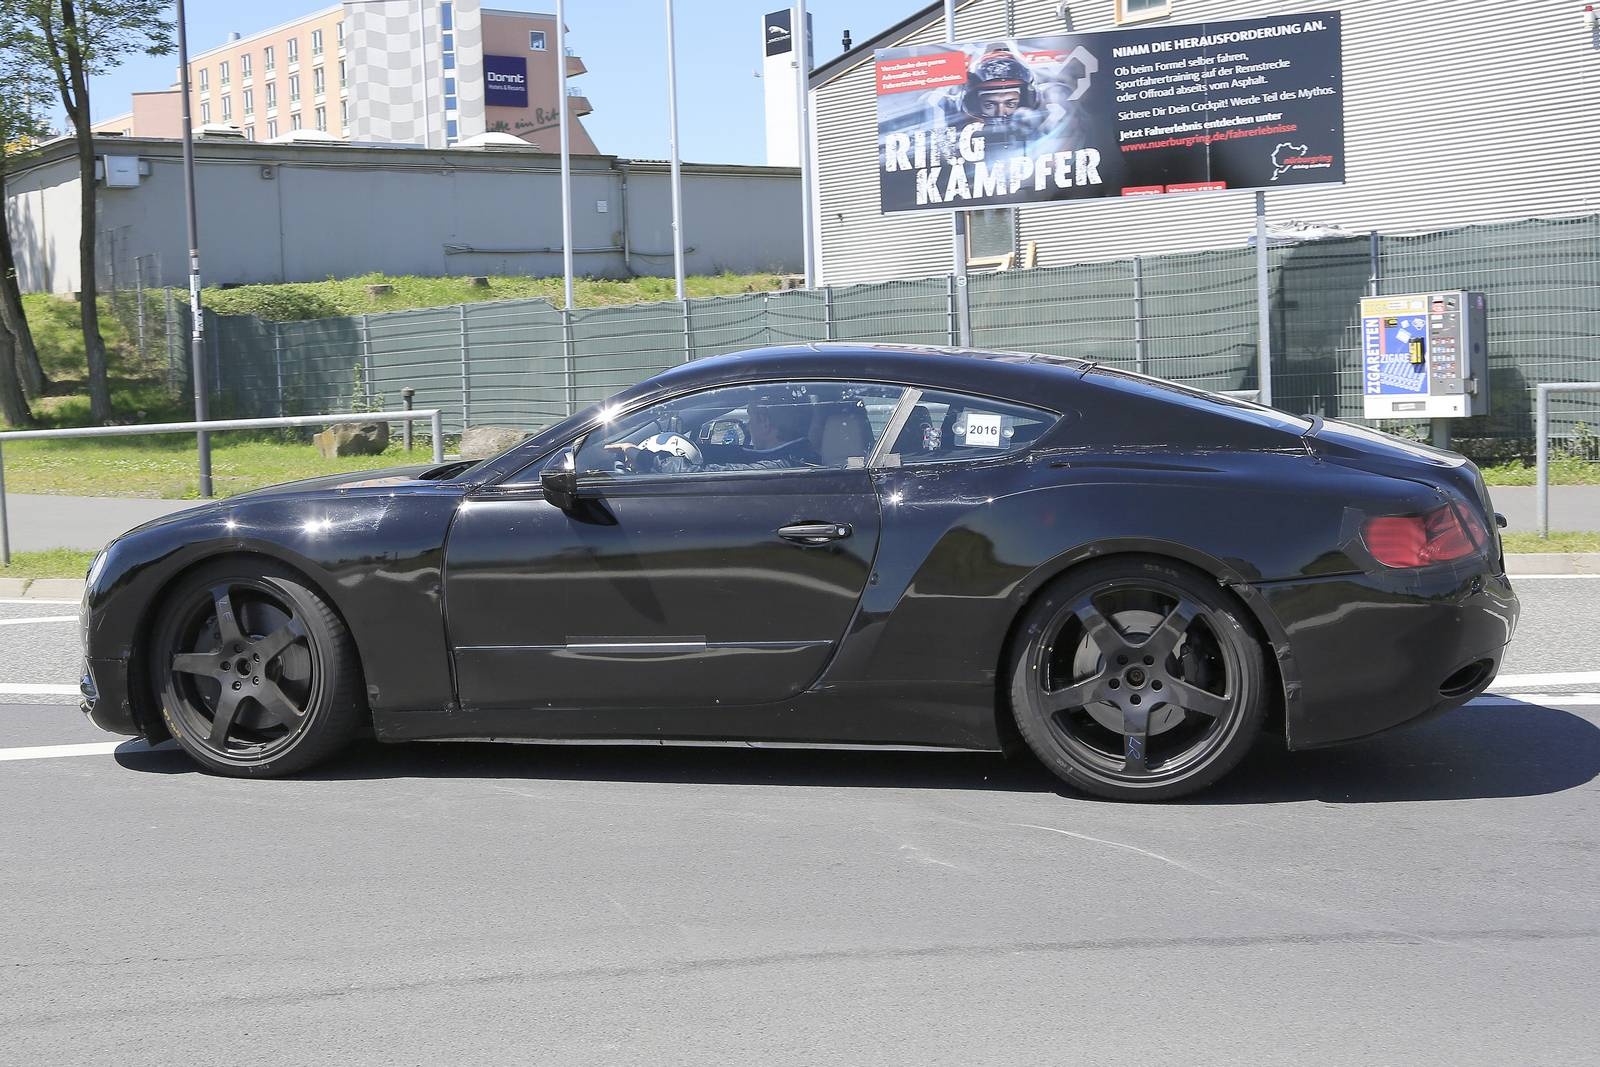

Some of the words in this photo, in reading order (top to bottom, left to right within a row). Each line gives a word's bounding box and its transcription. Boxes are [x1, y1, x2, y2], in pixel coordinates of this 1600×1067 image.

[1112, 43, 1150, 58] NIMM
[1151, 40, 1173, 53] DIE
[1174, 23, 1302, 50] HERAUSFORDERUNG
[1303, 20, 1327, 33] AN.
[487, 71, 524, 83] Dorint
[1114, 66, 1130, 77] Ob
[1130, 64, 1154, 75] beim
[1155, 58, 1187, 71] Formel
[1187, 56, 1216, 67] selber
[1216, 53, 1249, 64] fahren,
[1115, 71, 1201, 91] Sportfahrertraining
[1201, 67, 1217, 79] auf
[1217, 66, 1234, 77] der
[1235, 59, 1291, 74] Rennstrecke
[1116, 92, 1138, 102] oder
[1138, 86, 1175, 100] Offroad
[1175, 83, 1208, 95] abseits
[1208, 81, 1230, 91] vom
[1231, 75, 1268, 89] Asphalt.
[1118, 110, 1151, 121] Sichere
[1152, 107, 1167, 117] Dir
[1168, 104, 1190, 115] Dein
[1191, 99, 1229, 112] Cockpit!
[1230, 94, 1261, 107] Werde
[1261, 92, 1278, 103] Teil
[1279, 90, 1297, 101] des
[1298, 86, 1336, 100] Mythos.
[1119, 129, 1143, 142] Jetzt
[1144, 121, 1203, 137] Fahrerlebnis
[1203, 114, 1254, 129] entdecken
[1254, 112, 1284, 123] unter
[1120, 123, 1297, 152] www.nuerburgring.de/fahrerlebnisse
[885, 122, 985, 172] RING
[915, 147, 1103, 205] KÄMPFER
[1365, 319, 1381, 394] ZIGARETTEN
[969, 425, 998, 436] 2016
